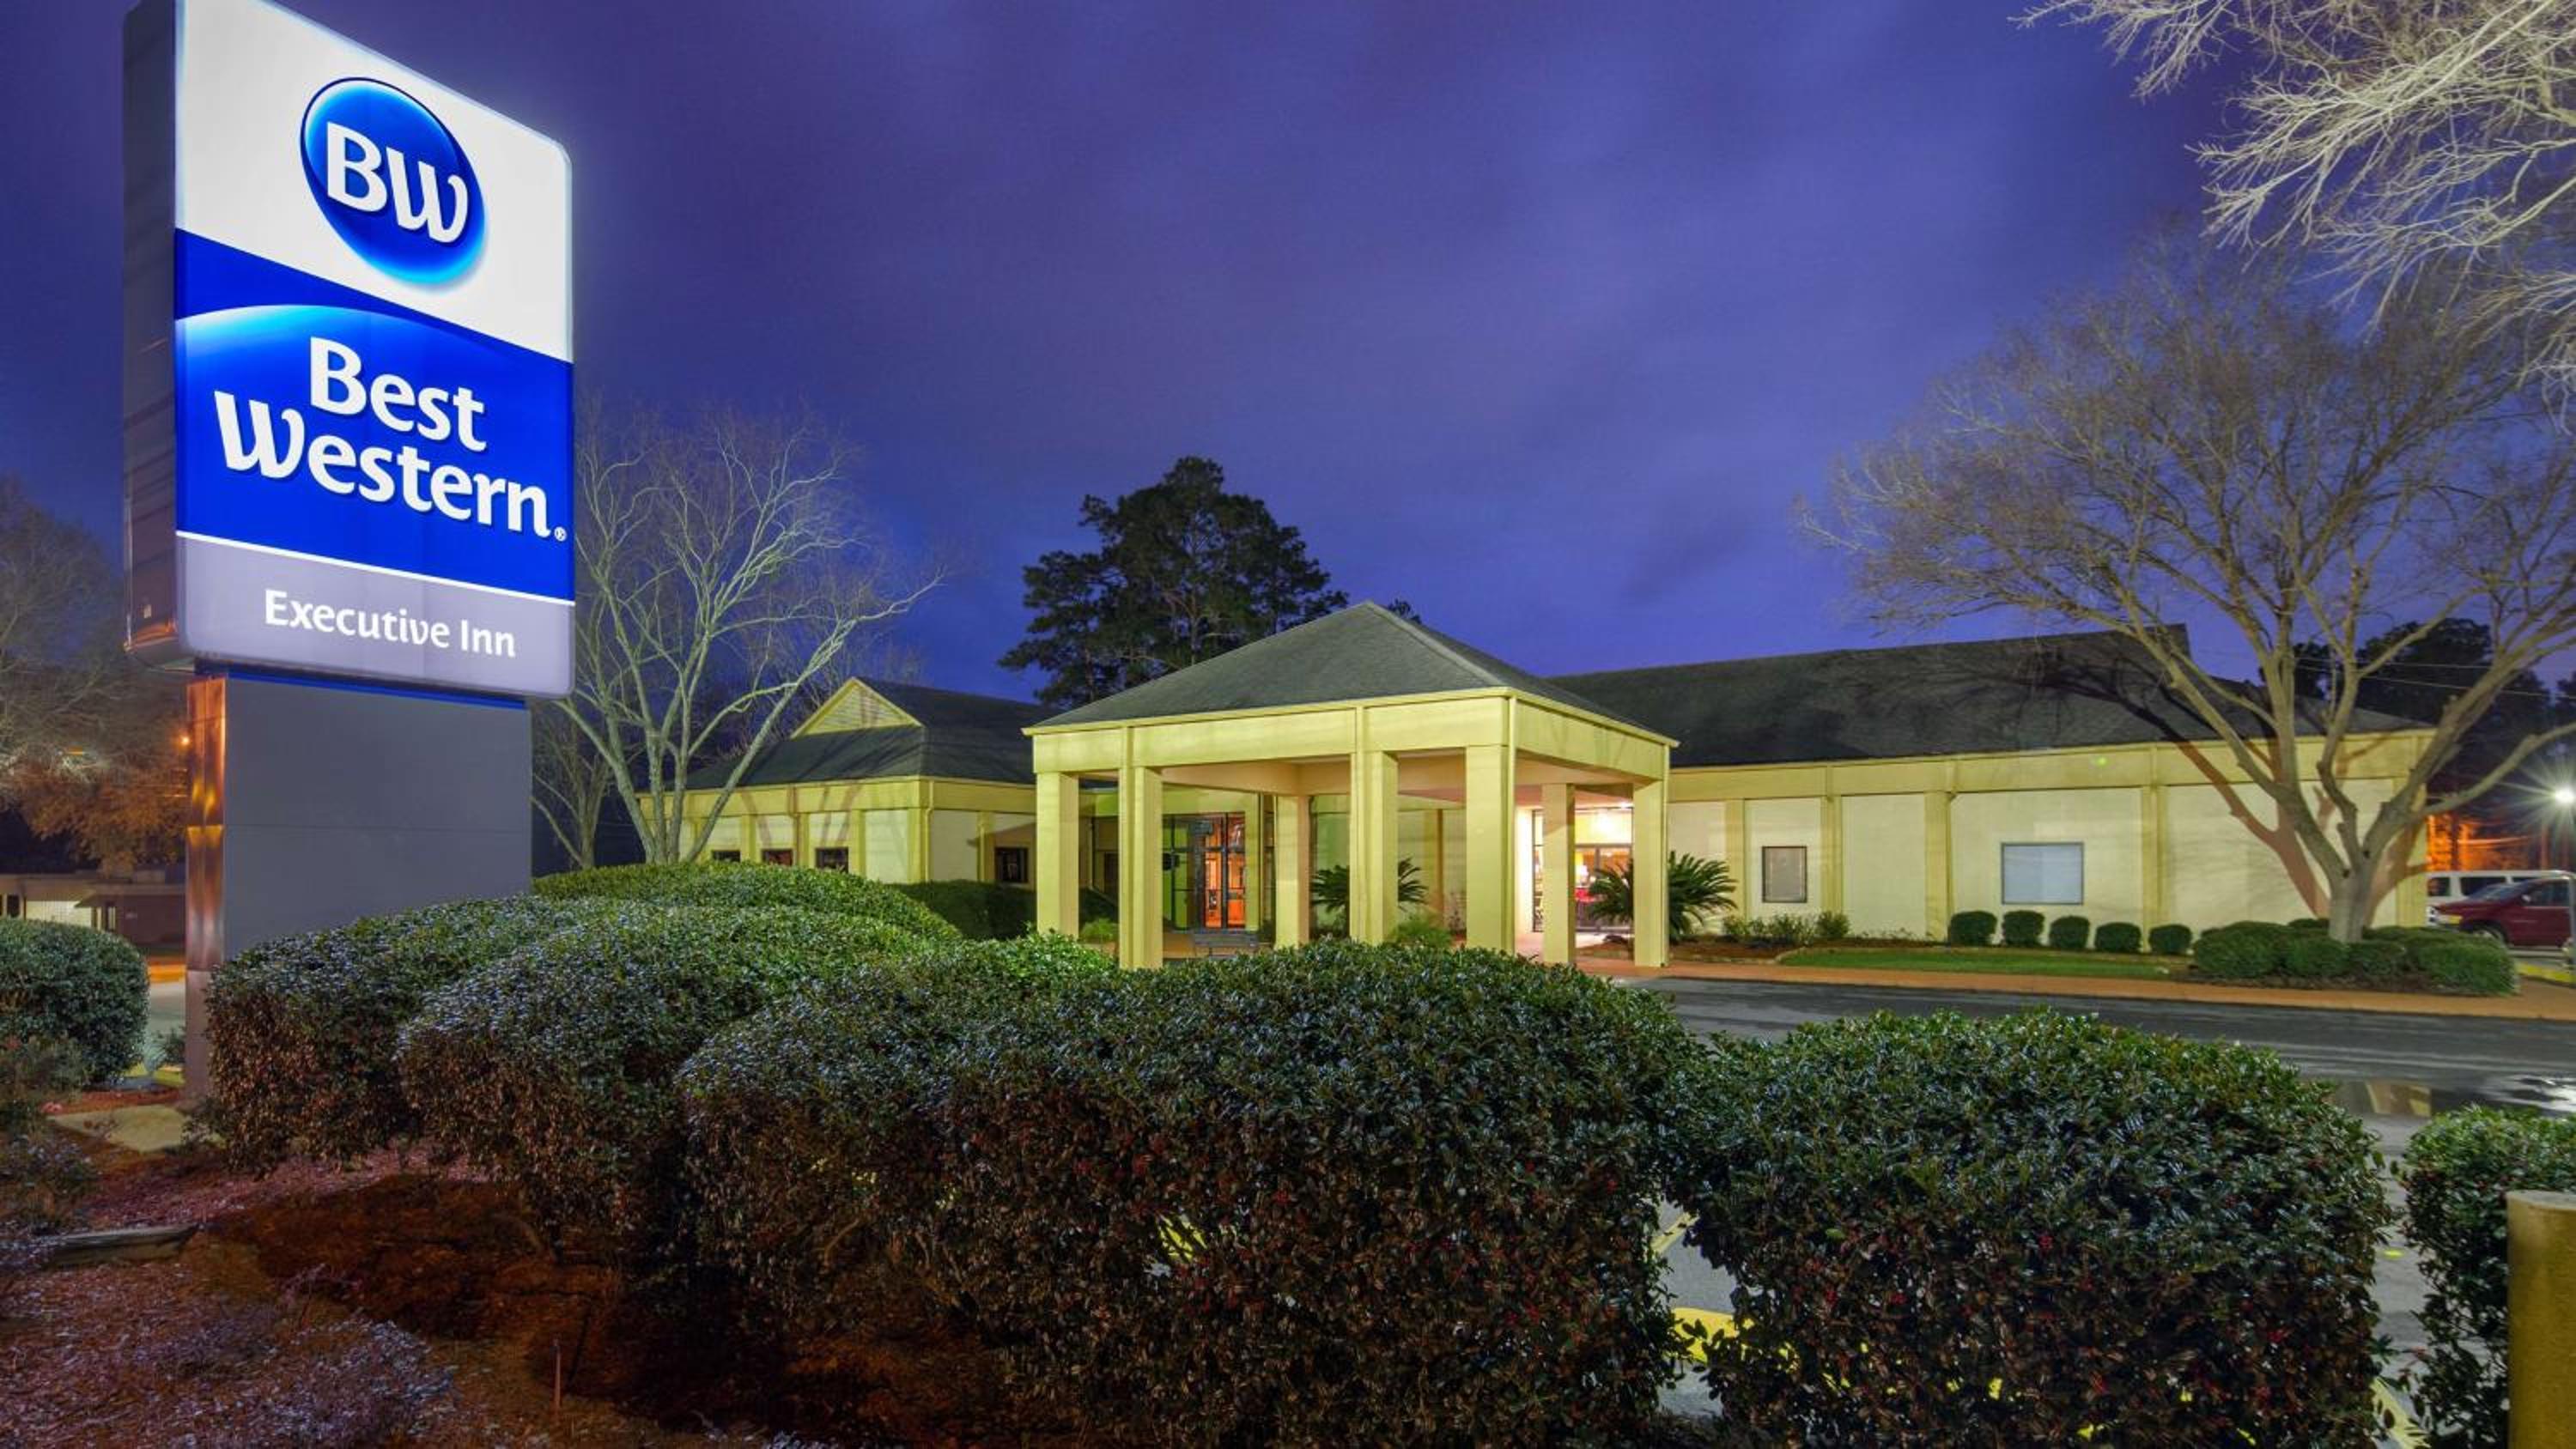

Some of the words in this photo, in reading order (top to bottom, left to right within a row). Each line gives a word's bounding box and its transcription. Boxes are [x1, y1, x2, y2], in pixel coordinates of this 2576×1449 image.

[326, 122, 469, 244] BW
[309, 336, 487, 452] Best
[264, 590, 450, 649] Executive
[461, 620, 516, 658] Inn
